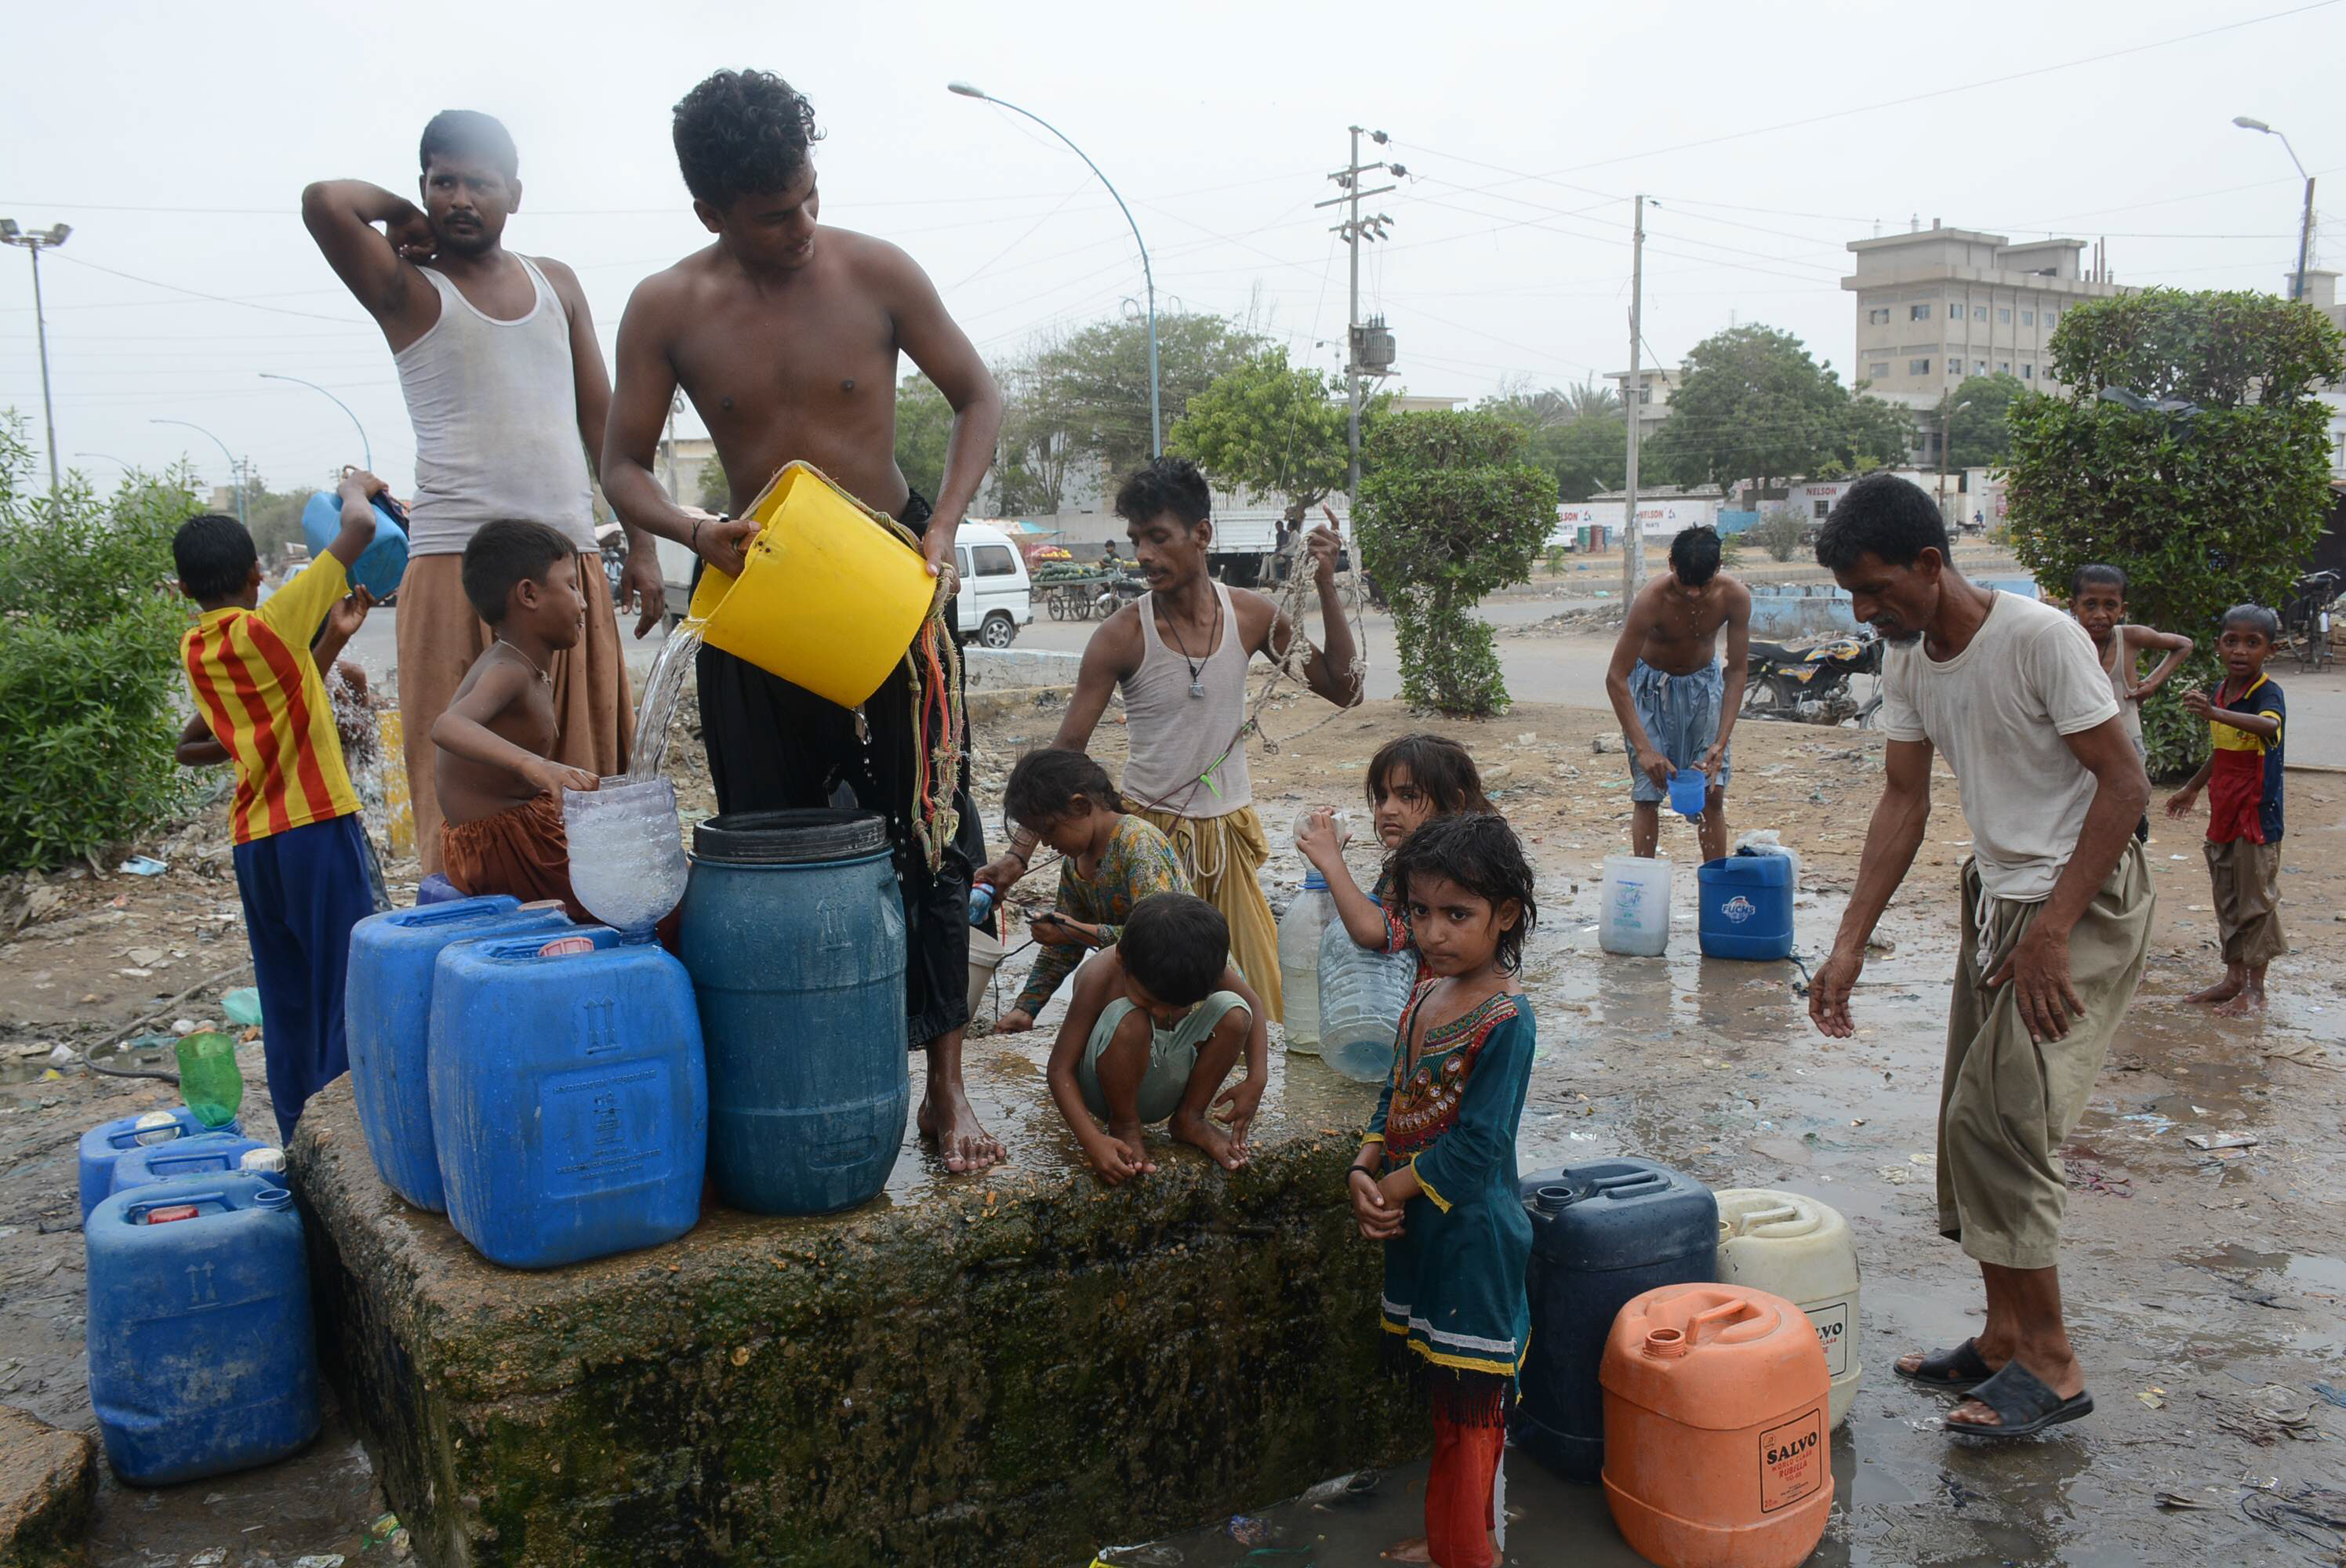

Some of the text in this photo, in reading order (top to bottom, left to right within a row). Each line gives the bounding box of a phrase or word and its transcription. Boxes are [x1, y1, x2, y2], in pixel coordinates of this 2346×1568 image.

[1806, 487, 1837, 495] NELSON
[1722, 903, 1756, 916] FUCHS
[1767, 1432, 1818, 1465] SALVO
[1772, 1459, 1794, 1472] WORLD
[1779, 1461, 1807, 1479] RUBELLA
